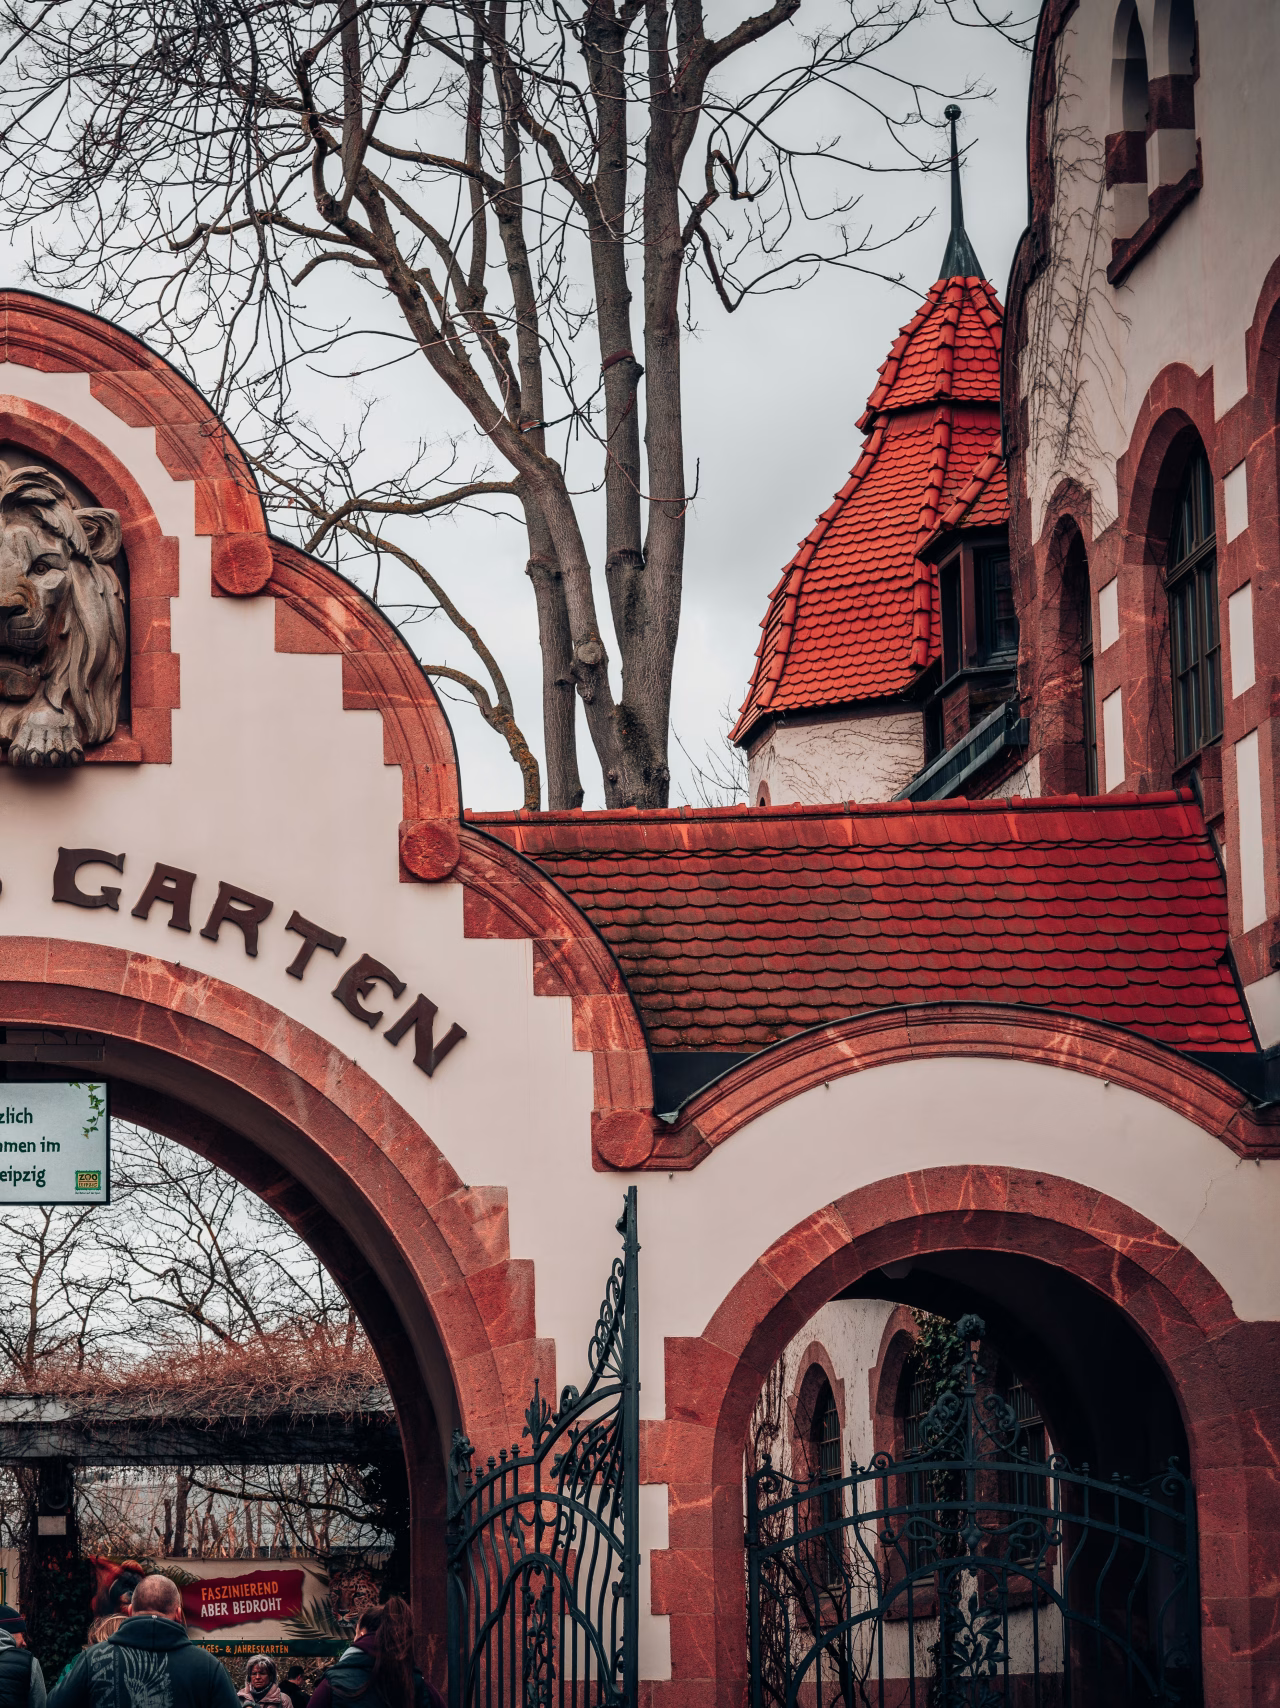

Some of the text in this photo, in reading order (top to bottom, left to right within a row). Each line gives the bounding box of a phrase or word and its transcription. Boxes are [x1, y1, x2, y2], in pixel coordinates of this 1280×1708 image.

[52, 846, 468, 1078] GARTEN
[40, 1136, 61, 1153] im
[79, 1173, 98, 1181] ZOO
[201, 1581, 279, 1601] FASZINIEREND
[201, 1597, 282, 1618] ABER BEDROHT
[225, 1645, 232, 1654] &
[234, 1644, 289, 1655] JAHRESKARTEN
